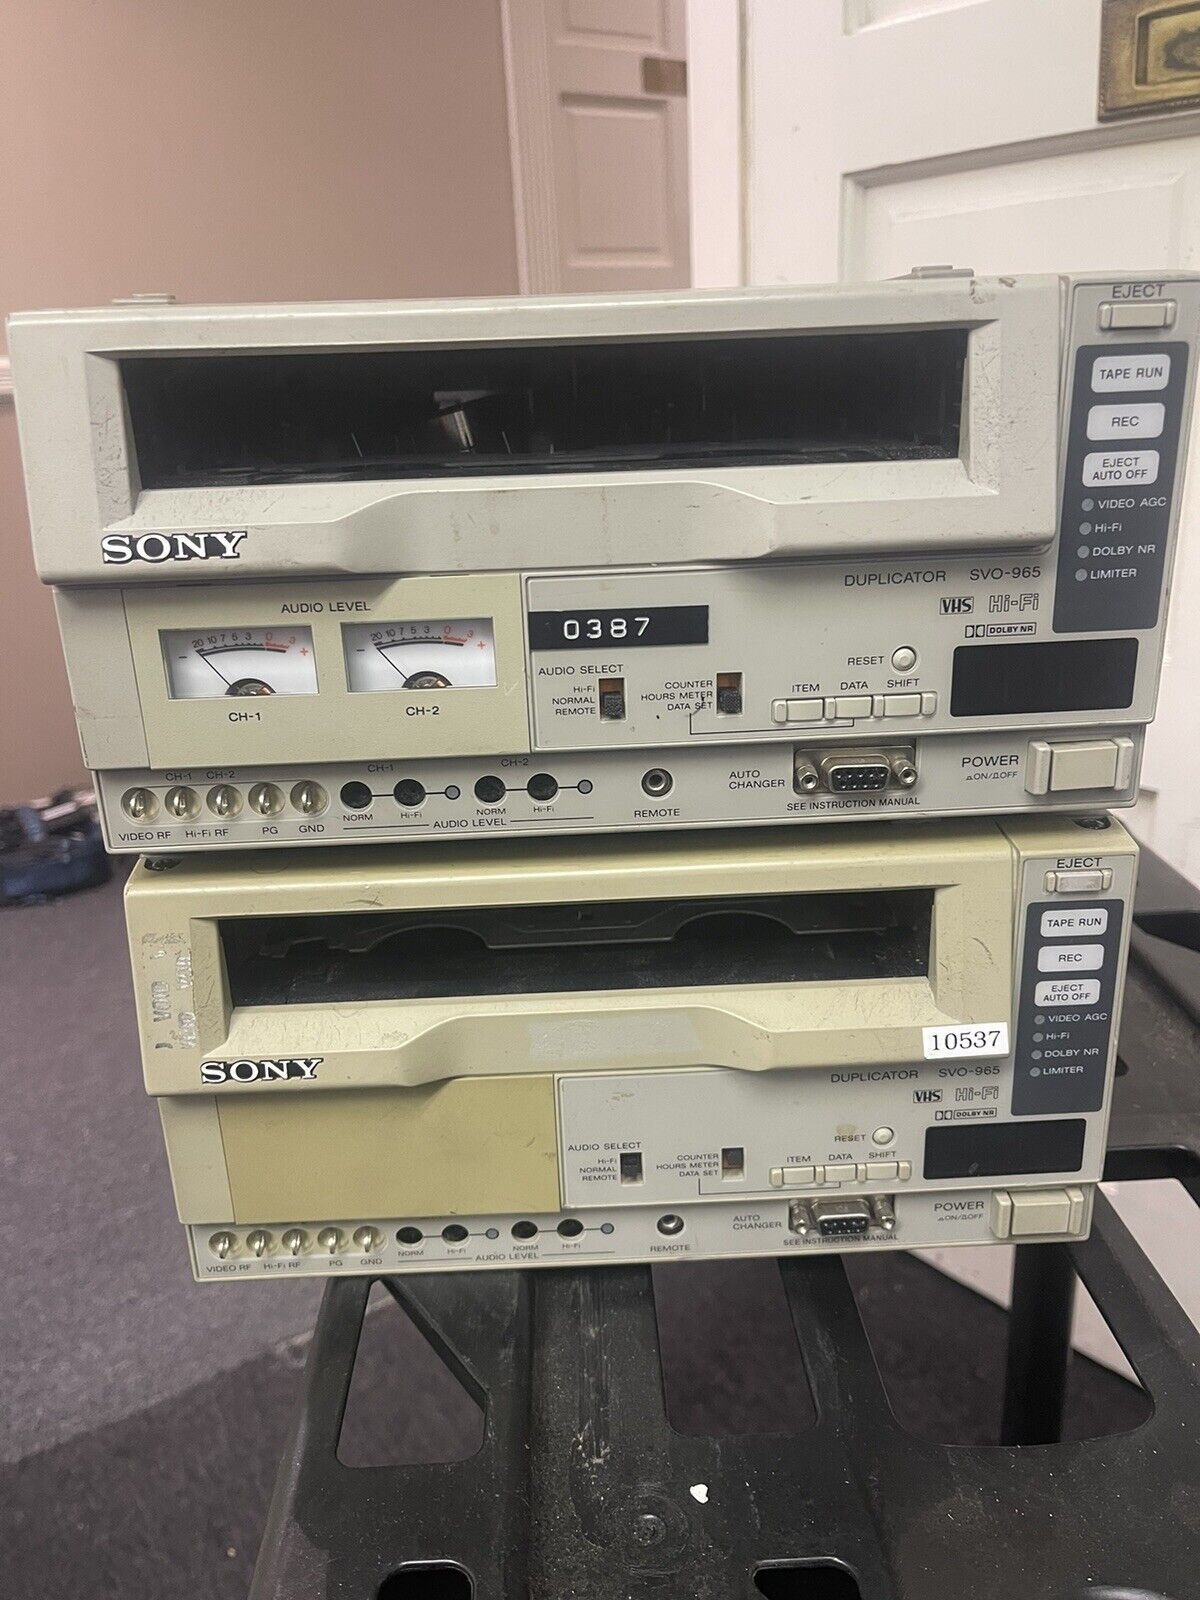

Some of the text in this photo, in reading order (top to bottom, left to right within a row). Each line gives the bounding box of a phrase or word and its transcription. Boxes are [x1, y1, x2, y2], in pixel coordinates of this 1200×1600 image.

[1112, 283, 1165, 299] EJECT
[1100, 367, 1163, 380] TAPE RUN
[1111, 416, 1140, 427] REC
[1102, 457, 1140, 468] EJECT
[1092, 469, 1148, 481] AUTO OFF
[1098, 497, 1167, 509] VIDEO AGC
[1095, 523, 1122, 533] Hi-Fi
[101, 530, 247, 565] SONY
[1092, 545, 1156, 557] DOLBY NR
[844, 566, 1042, 588] DUPLICATOR SVO-965
[1090, 568, 1137, 580] LIMITER
[281, 601, 371, 614] AUDIO LEVEL
[941, 593, 1040, 614] VHS Hi-Fi
[370, 632, 383, 641] 20
[385, 629, 396, 637] 10
[399, 627, 405, 636] 7
[411, 626, 417, 634] 5
[424, 626, 430, 634] 3
[563, 616, 650, 640] 0387
[989, 625, 1033, 634] DOLBY NR
[192, 639, 204, 648] 20
[207, 636, 217, 644] 10
[220, 634, 226, 642] 7
[232, 633, 238, 641] 5
[245, 632, 252, 640] 3
[847, 655, 885, 667] RESET
[538, 664, 624, 677] AUDIO SELECT
[665, 680, 713, 690] COUNTER
[792, 677, 920, 693] ITEM DATA SHIFT
[552, 697, 596, 706] NORMAL
[641, 691, 713, 701] HOURS METER
[405, 706, 440, 717] CH-2
[667, 701, 713, 711] DATA SET
[229, 712, 261, 723] CH-1
[555, 707, 596, 717] REMOTE
[500, 758, 529, 768] CH-2
[962, 755, 1019, 768] POWER
[367, 764, 394, 773] CH-1
[165, 770, 236, 782] CH-1 CH-2
[729, 770, 761, 779] AUTO
[729, 779, 785, 790] CHANGER
[787, 797, 920, 812] SEE INSTRUCTION MANUAL
[343, 811, 422, 822] NORM Hi-Fi
[476, 807, 506, 816] NORM
[634, 809, 680, 819] REMOTE
[433, 817, 507, 829] AUDIO LEVEL
[118, 824, 325, 842] VIDEO RF Hi-Fi RF PG GND
[1056, 857, 1103, 869] EJECT
[1048, 918, 1102, 928] TAPE RUN
[1058, 953, 1083, 962] REC
[1051, 983, 1084, 993] EJECT
[1043, 992, 1091, 1002] AUTO OFF
[1048, 1012, 1108, 1023] VIDEO AGC
[931, 1030, 1001, 1051] 10537
[1046, 1032, 1070, 1041] Hi-Fi
[1044, 1048, 1100, 1058] DOLBY NR
[200, 1057, 324, 1085] SONY
[831, 1066, 1001, 1084] DUPLICATOR SVO-965
[1043, 1066, 1084, 1075] LIMITER
[915, 1086, 999, 1103] VHS Hi-Fi
[834, 1134, 866, 1143] RESET
[568, 1142, 642, 1152] AUDIO SELECT
[677, 1153, 719, 1161] COUNTER
[787, 1151, 897, 1163] ITEM DATA SHIFT
[579, 1166, 617, 1174] NORMAL
[689, 1161, 719, 1169] METER
[582, 1174, 617, 1182] REMOTE
[703, 1169, 719, 1177] SET
[934, 1200, 985, 1212] POWER
[733, 1215, 760, 1223] AUTO
[732, 1221, 782, 1231] CHANGER
[783, 1234, 899, 1246] SEE INSTRUCTION MANUAL
[650, 1244, 691, 1252] REMOTE
[475, 1252, 539, 1262] AUDIO LEVEL
[288, 1261, 301, 1269] RF
[329, 1259, 343, 1267] PG
[360, 1258, 383, 1266] GND
